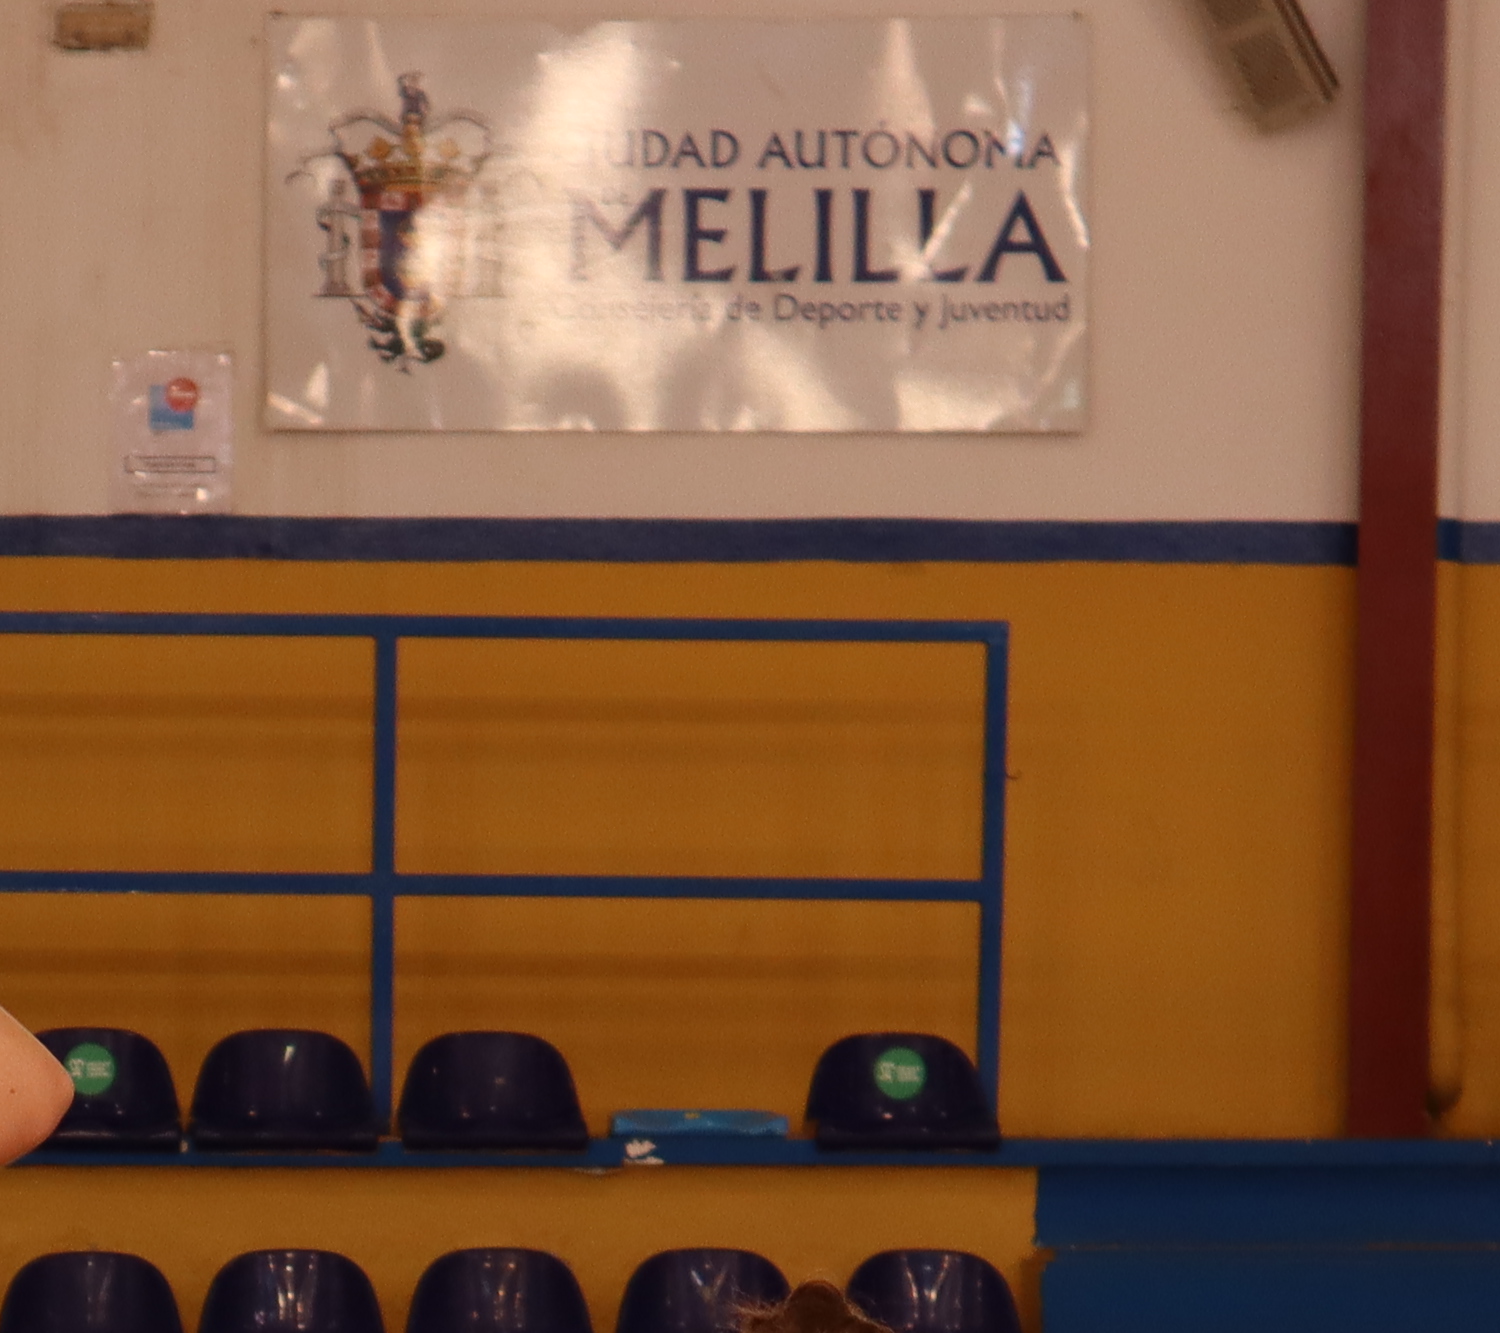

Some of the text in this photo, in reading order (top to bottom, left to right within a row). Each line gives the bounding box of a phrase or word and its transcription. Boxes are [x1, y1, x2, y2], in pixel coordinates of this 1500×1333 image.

[568, 186, 1068, 283] MELILLA
[773, 294, 900, 330] Deporte
[912, 299, 930, 330] y
